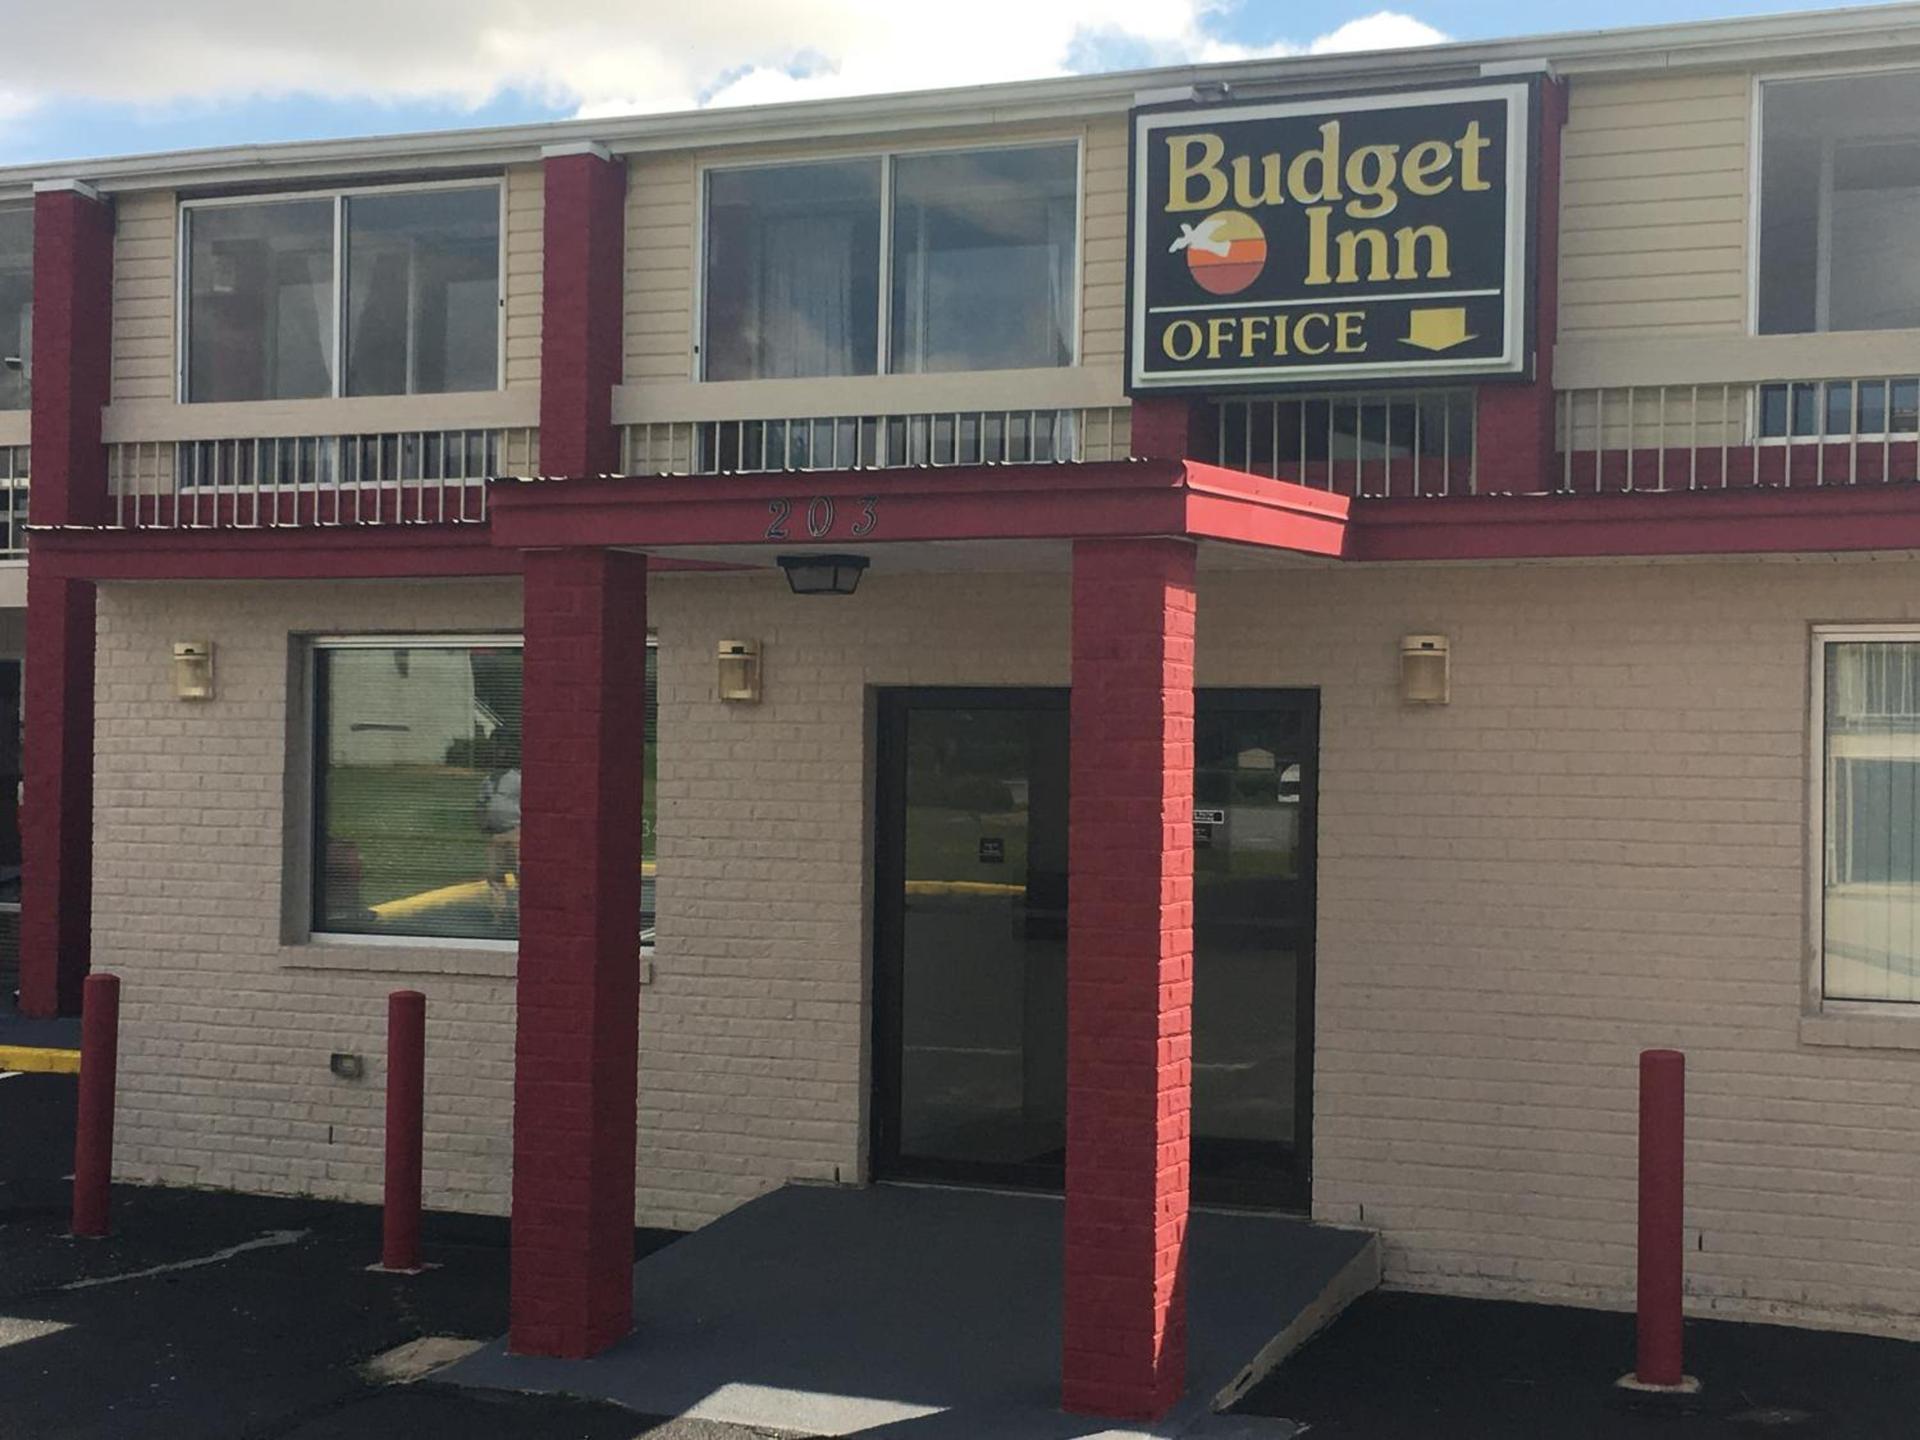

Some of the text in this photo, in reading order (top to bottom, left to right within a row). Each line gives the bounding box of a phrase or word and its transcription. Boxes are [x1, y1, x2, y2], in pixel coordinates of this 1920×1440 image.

[1164, 120, 1491, 219] Budget
[1304, 206, 1451, 286] Inn
[1162, 311, 1368, 361] OFFICE
[765, 495, 880, 539] 203
